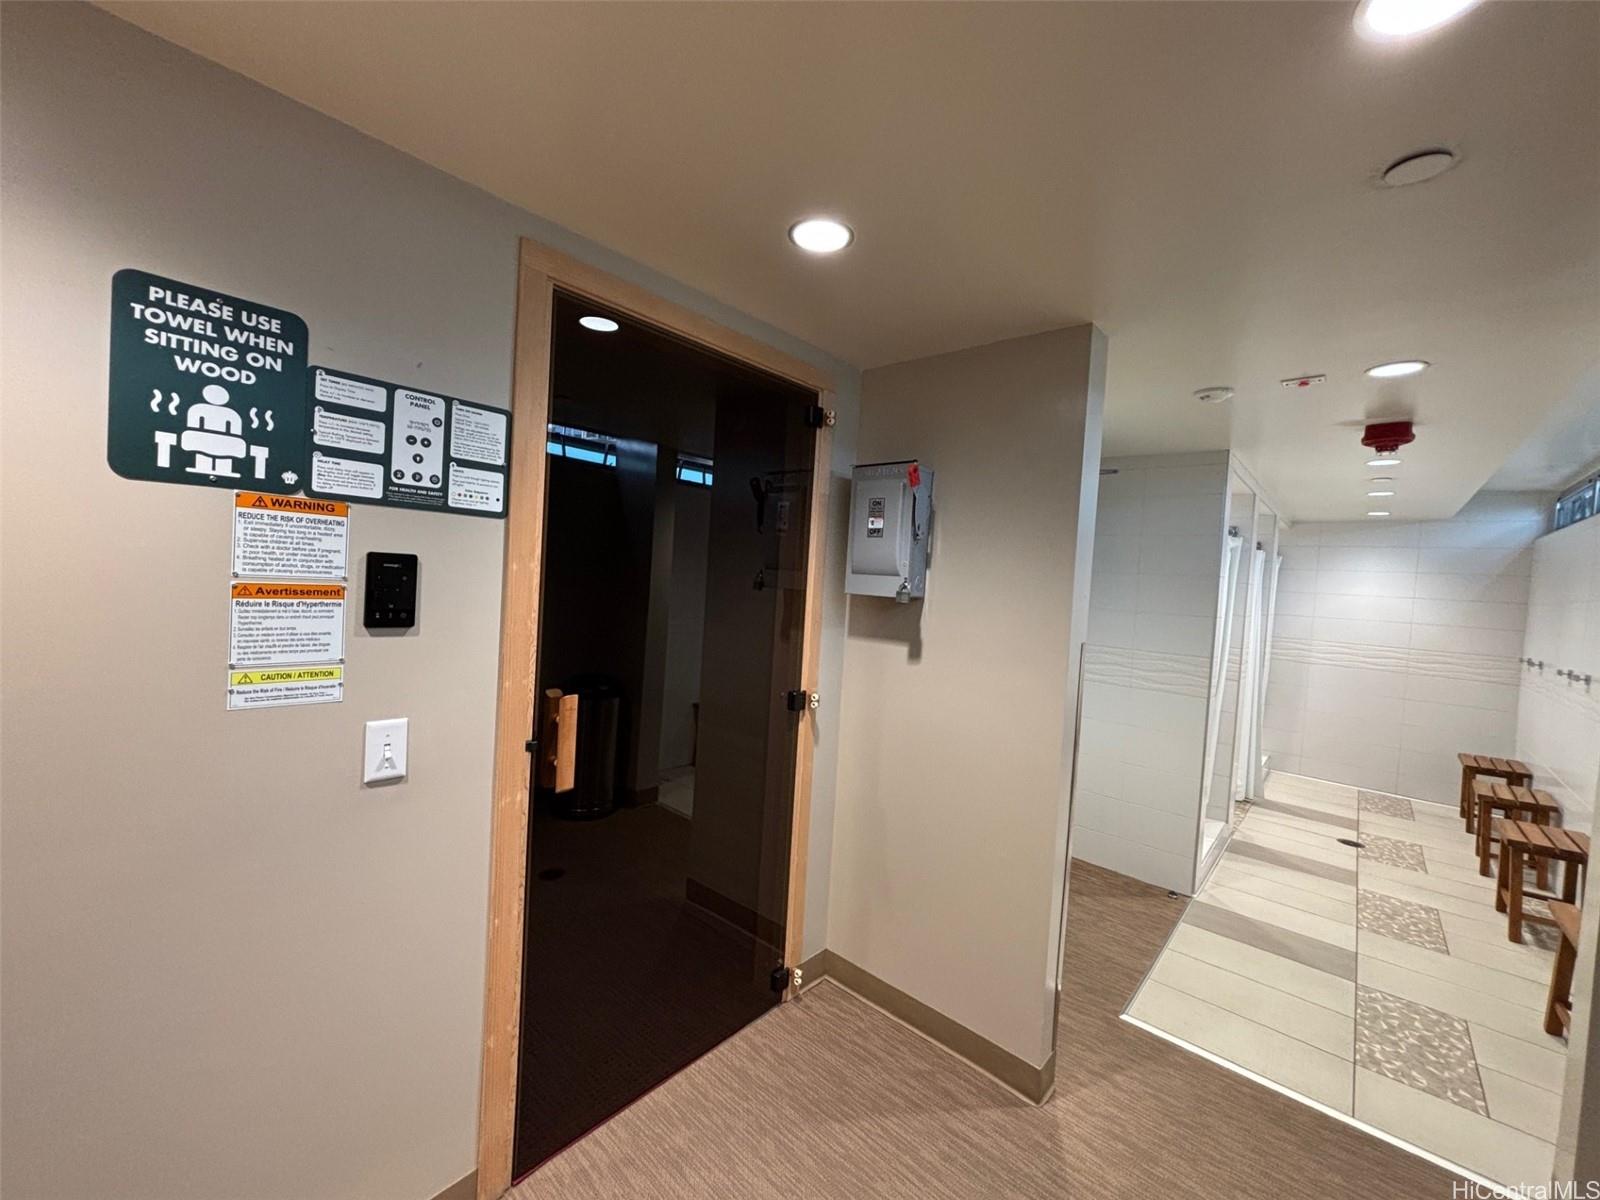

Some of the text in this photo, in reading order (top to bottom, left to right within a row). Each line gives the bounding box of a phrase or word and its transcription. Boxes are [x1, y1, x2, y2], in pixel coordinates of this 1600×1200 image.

[148, 286, 281, 334] PLEASE USE
[130, 303, 294, 356] TOWEL WHEN
[144, 328, 282, 372] SITTING ON
[174, 356, 256, 385] WOOD
[405, 393, 436, 405] CONTROL
[410, 402, 430, 410] PANEL
[270, 498, 335, 512] WARNING
[238, 512, 265, 520] REDUCE
[305, 518, 344, 526] OVERHEATING
[255, 587, 341, 597] Avertissement
[260, 672, 292, 681] CAUTION
